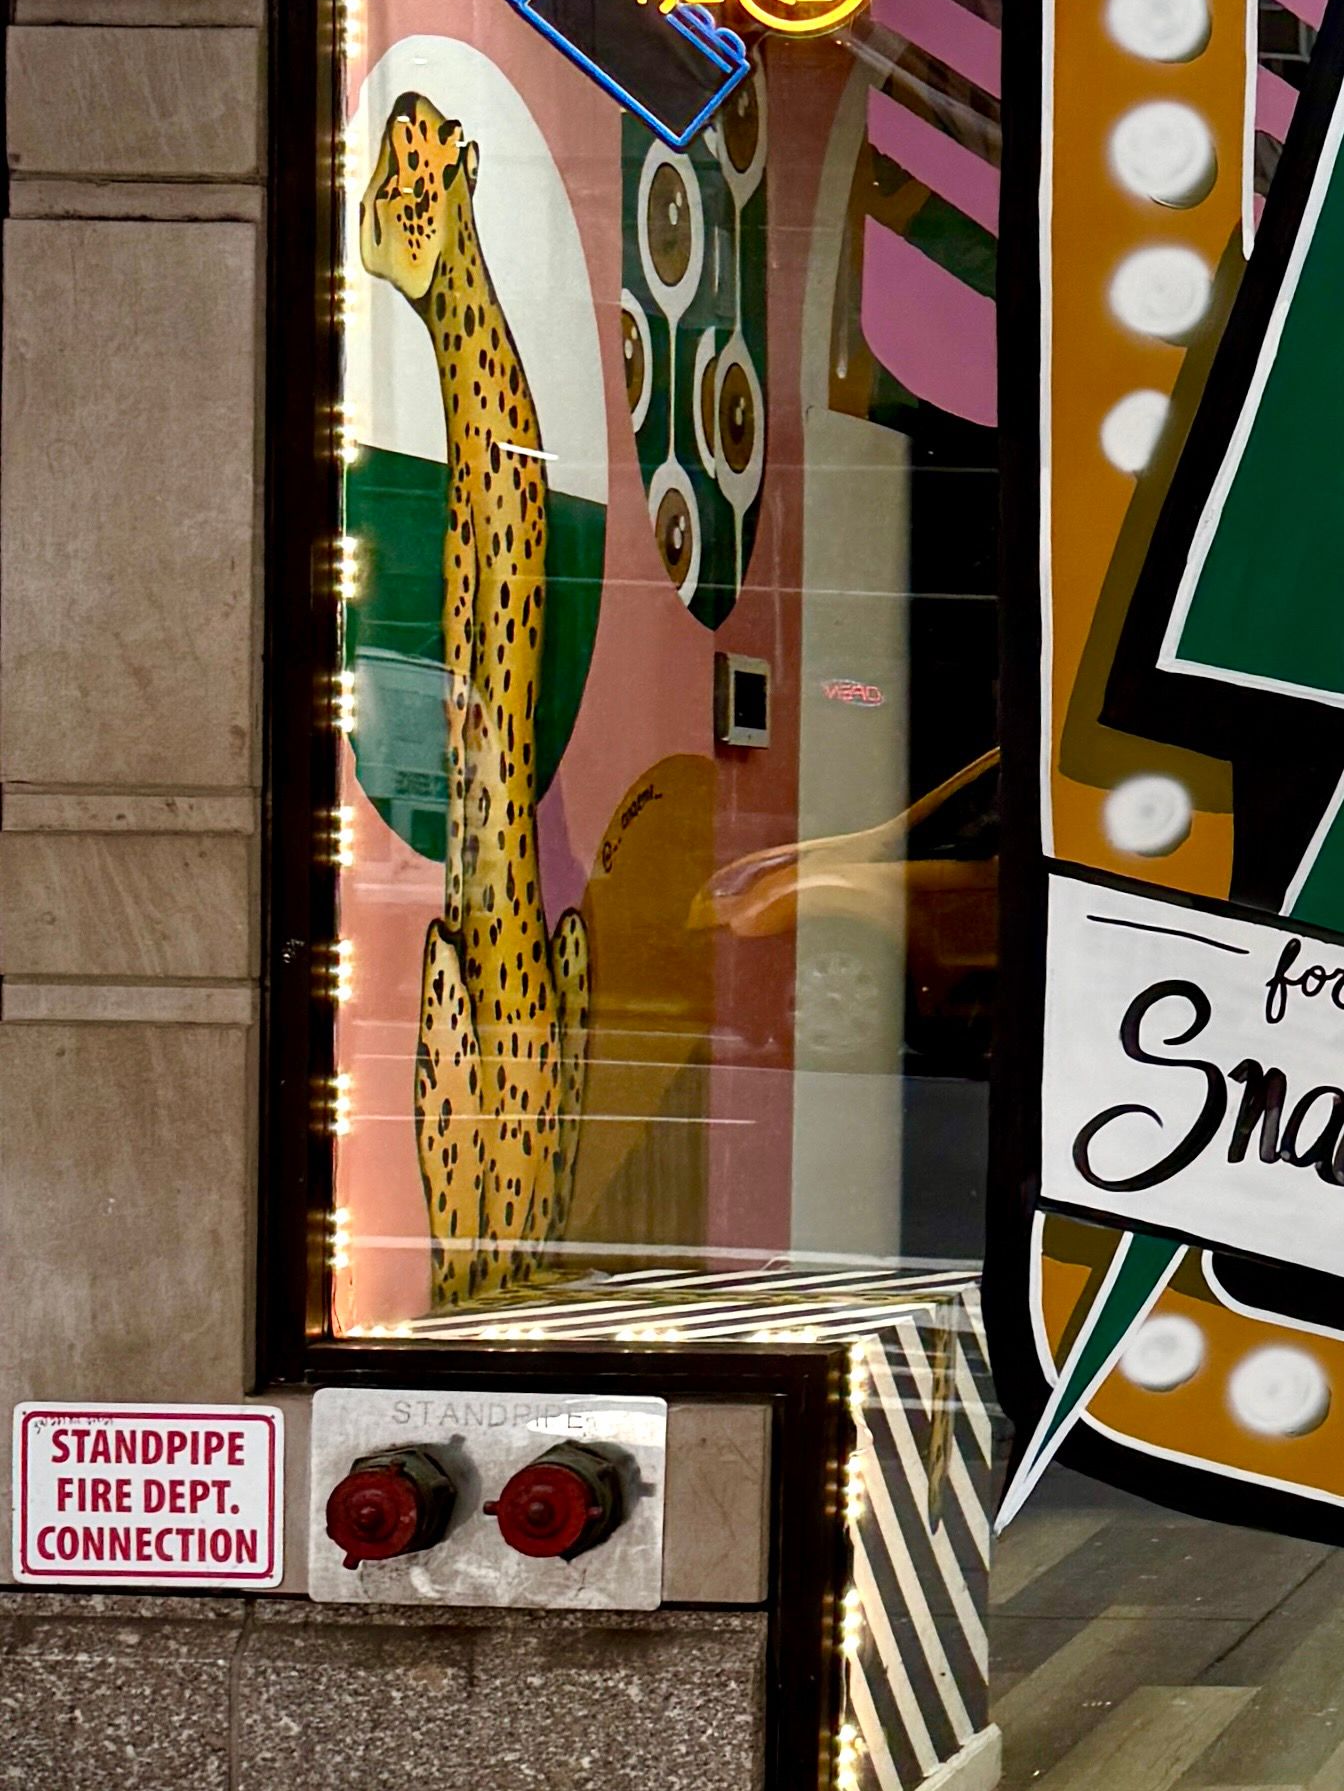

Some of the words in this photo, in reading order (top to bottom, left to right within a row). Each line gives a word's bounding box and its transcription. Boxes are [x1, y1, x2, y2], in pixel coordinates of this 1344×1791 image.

[392, 1400, 585, 1428] STANDPIPE
[51, 1429, 245, 1465] STANDPIPE
[57, 1478, 132, 1513] FIRE
[144, 1479, 240, 1514] DEPT.
[37, 1526, 258, 1563] CONNECTION
